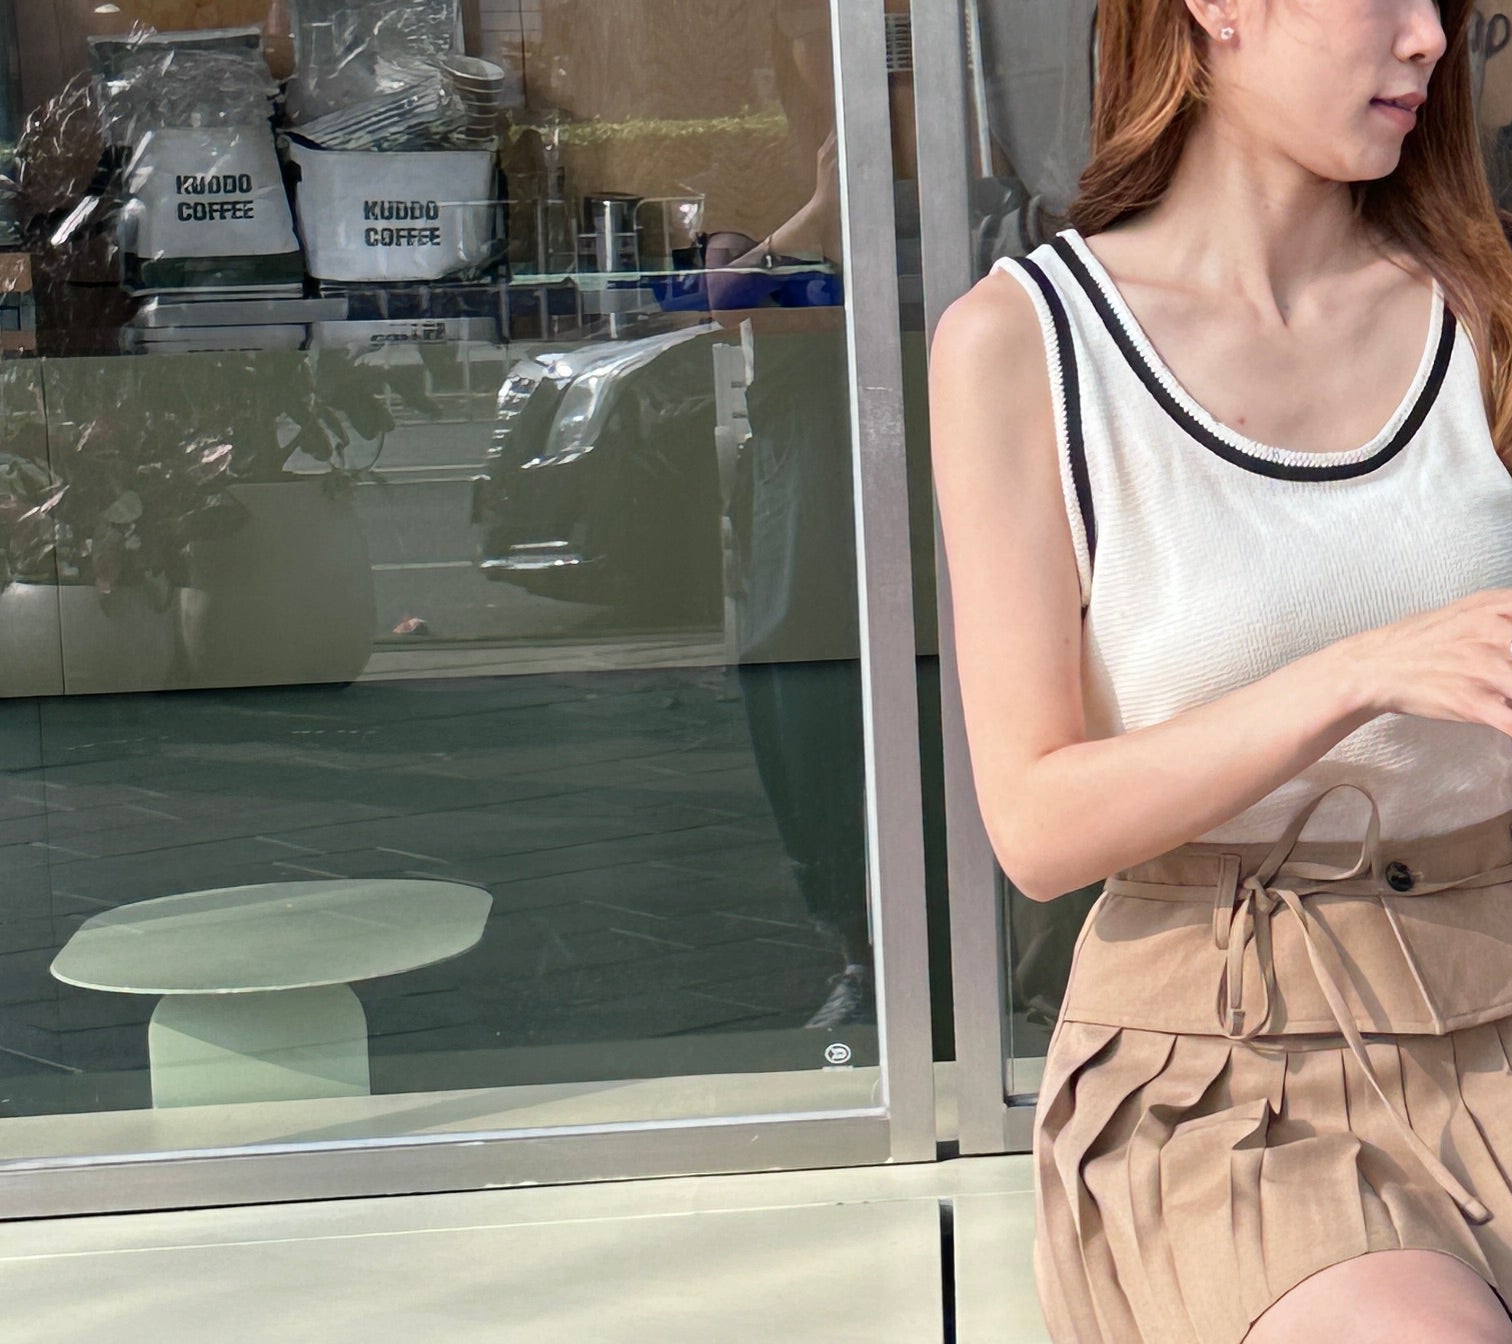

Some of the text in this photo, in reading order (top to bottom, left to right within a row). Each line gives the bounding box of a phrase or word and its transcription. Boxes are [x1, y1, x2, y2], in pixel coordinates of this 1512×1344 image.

[176, 173, 252, 195] KUDDO
[177, 200, 254, 222] COFFEE
[364, 200, 440, 221] KUDDO
[364, 227, 441, 247] COFFEE
